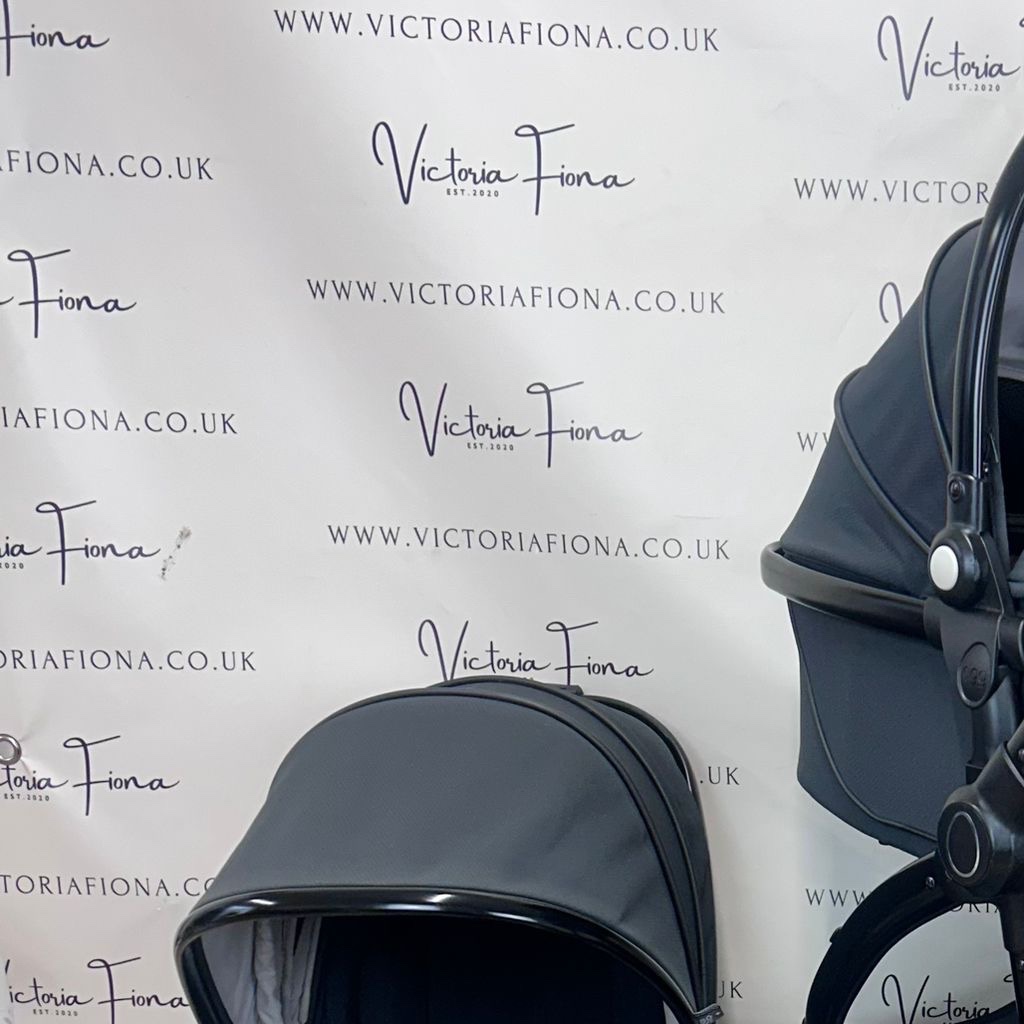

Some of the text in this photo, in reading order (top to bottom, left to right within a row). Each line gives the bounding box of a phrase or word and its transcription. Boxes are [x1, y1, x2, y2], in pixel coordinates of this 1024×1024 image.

[274, 9, 719, 52] WWW.VICTORIAFIONA.CO.UK
[877, 15, 1021, 101] Victoria
[948, 83, 1001, 92] EST.2020
[0, 149, 214, 180] FIONA.CO.UK
[372, 121, 635, 216] Victoria Fiona
[446, 187, 500, 198] EST.2020
[8, 249, 137, 339] Fiona
[306, 278, 725, 314] WWW.VICTORIAFIONA.CO.UK
[399, 381, 643, 468] Victoria Fiona
[36, 500, 161, 585] Fiona
[328, 524, 730, 560] WWW.VICTORIAFIONA.CO.UK
[418, 619, 654, 686] Victoria Fiona
[63, 735, 180, 816] Fiona
